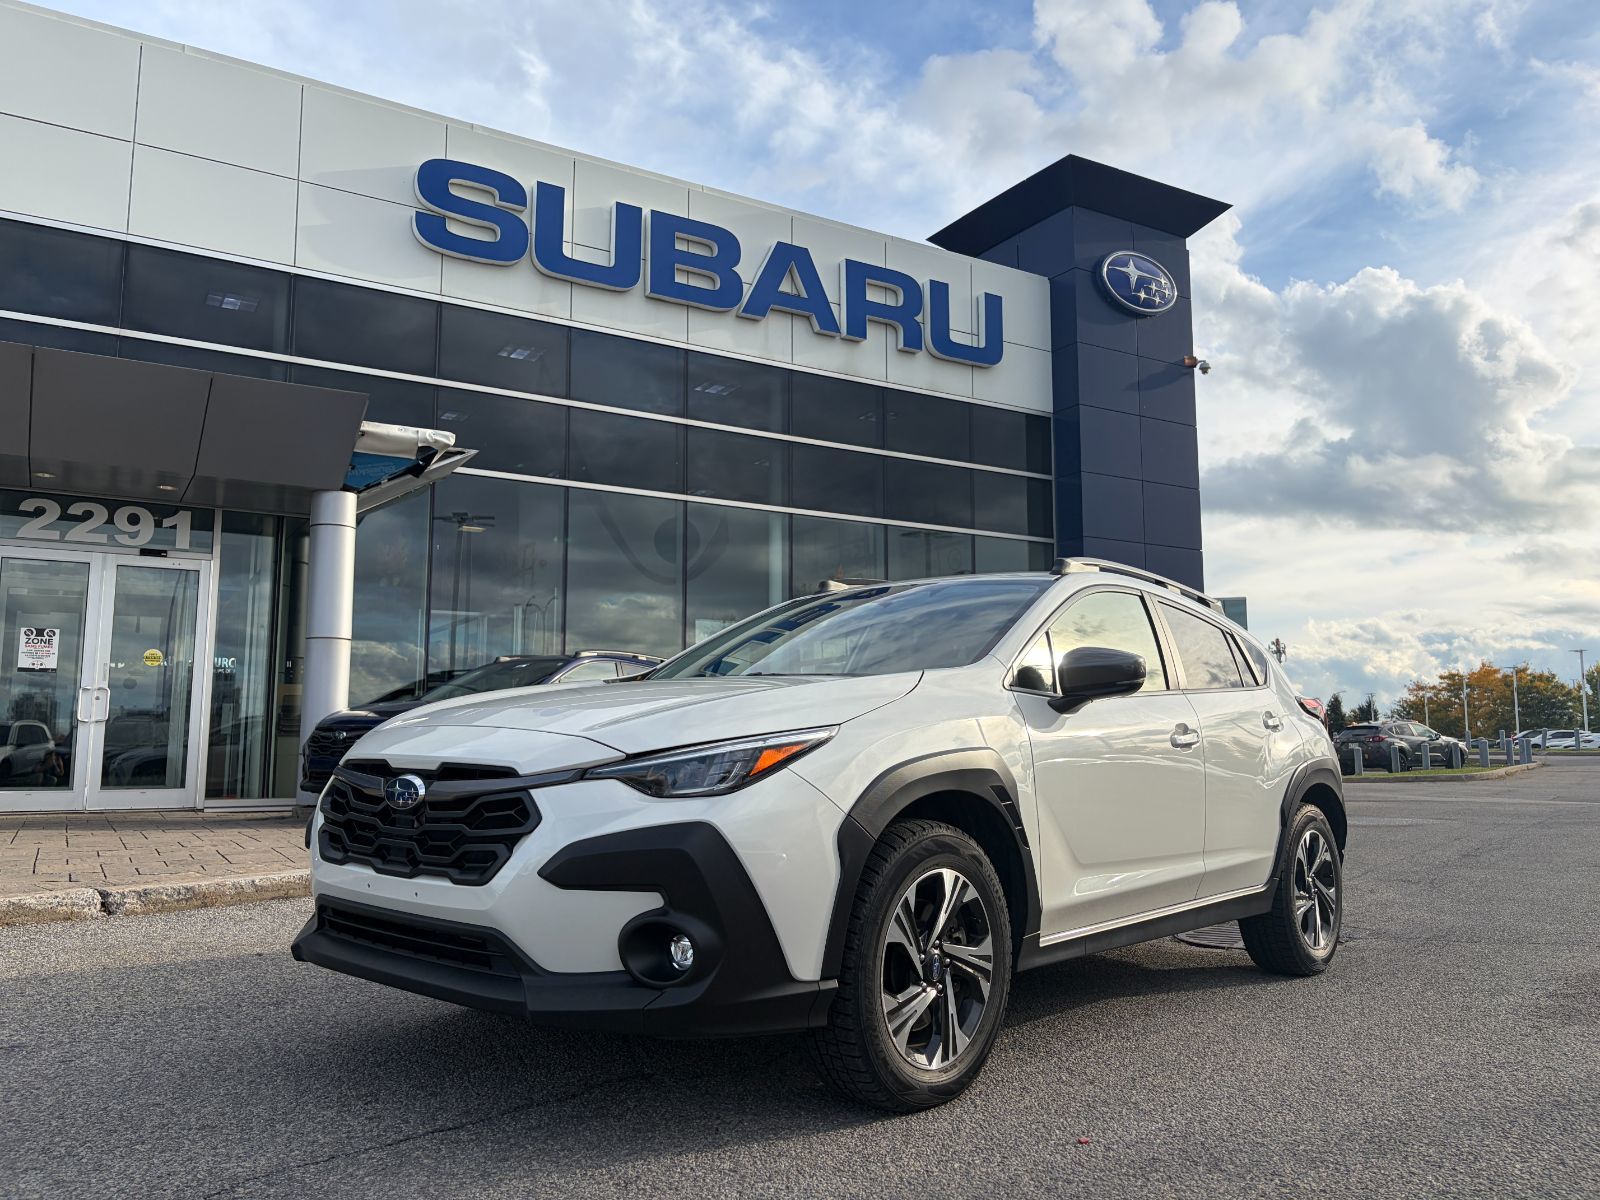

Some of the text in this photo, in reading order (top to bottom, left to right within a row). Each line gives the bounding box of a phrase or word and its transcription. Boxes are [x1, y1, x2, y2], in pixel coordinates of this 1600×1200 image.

[412, 158, 1003, 368] SUBARU
[16, 498, 192, 549] 2291
[25, 637, 54, 646] ZONE
